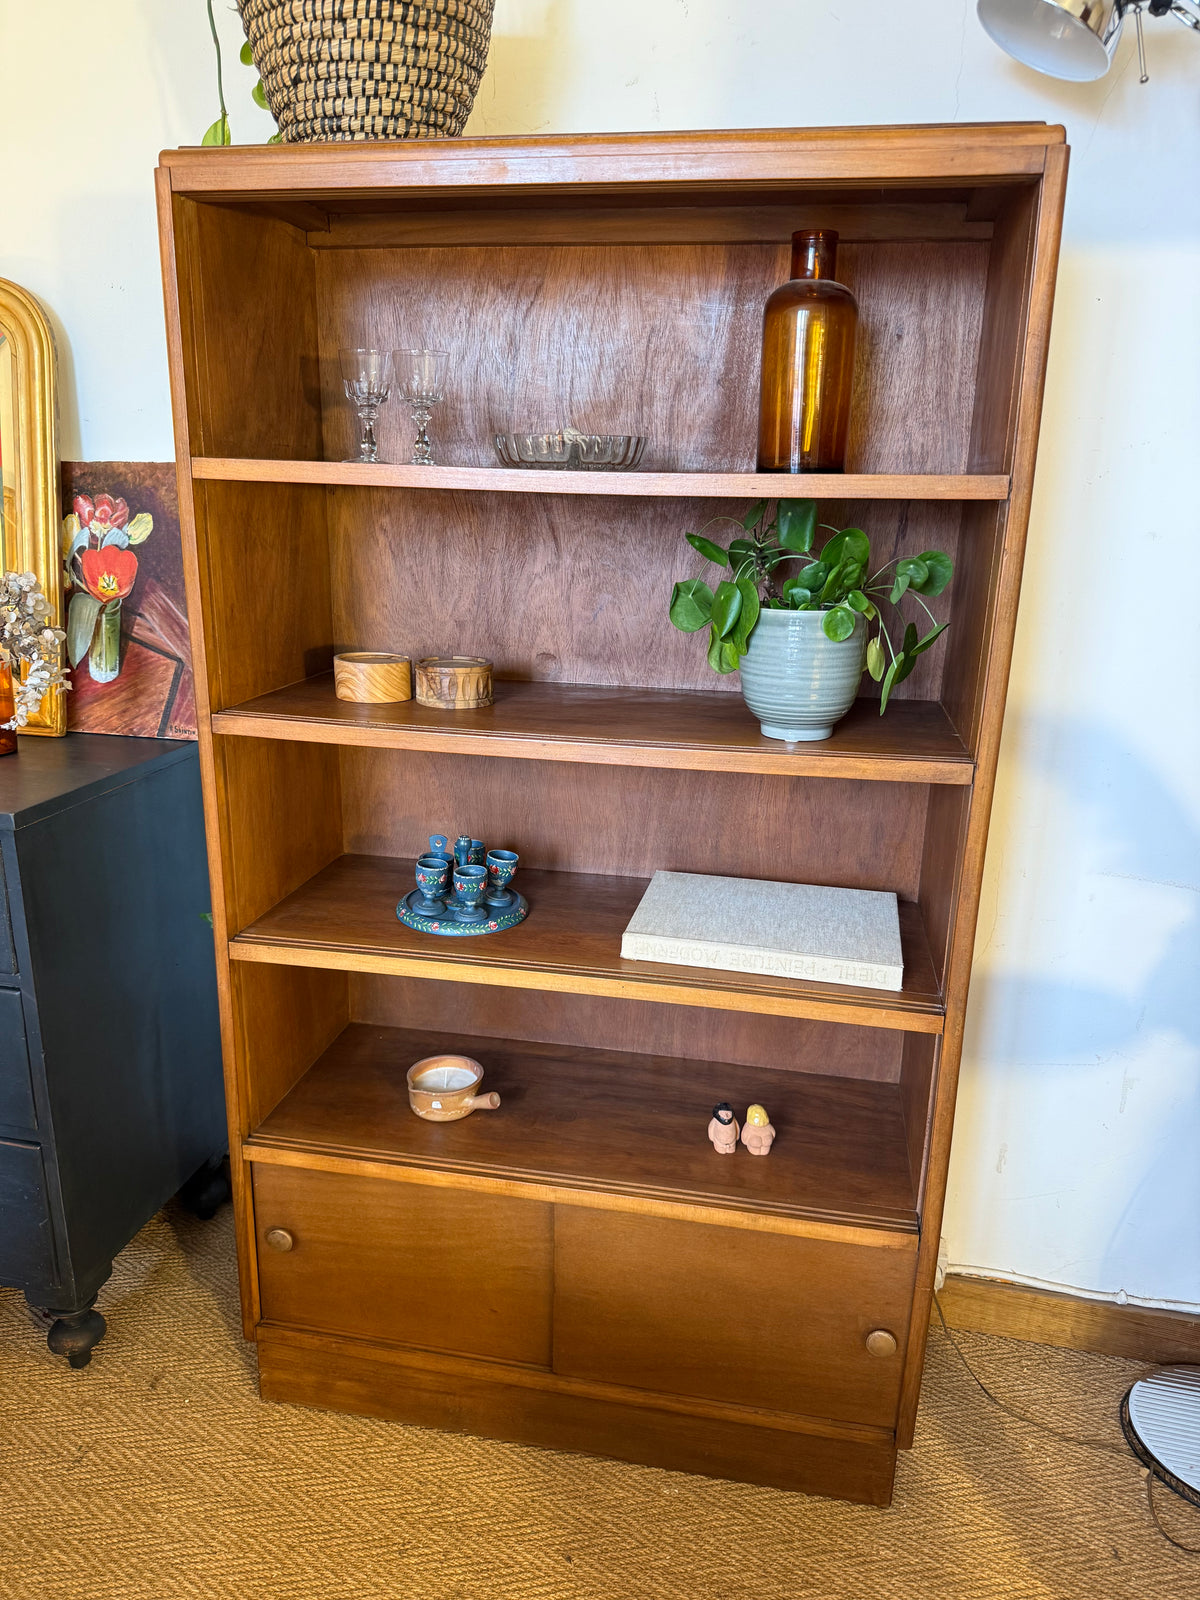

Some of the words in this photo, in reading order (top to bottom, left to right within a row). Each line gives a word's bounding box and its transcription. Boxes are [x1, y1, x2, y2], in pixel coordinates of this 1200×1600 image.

[634, 939, 721, 965] MODERNE
[729, 951, 817, 976] PEINTURE
[832, 964, 888, 985] DIEHL
